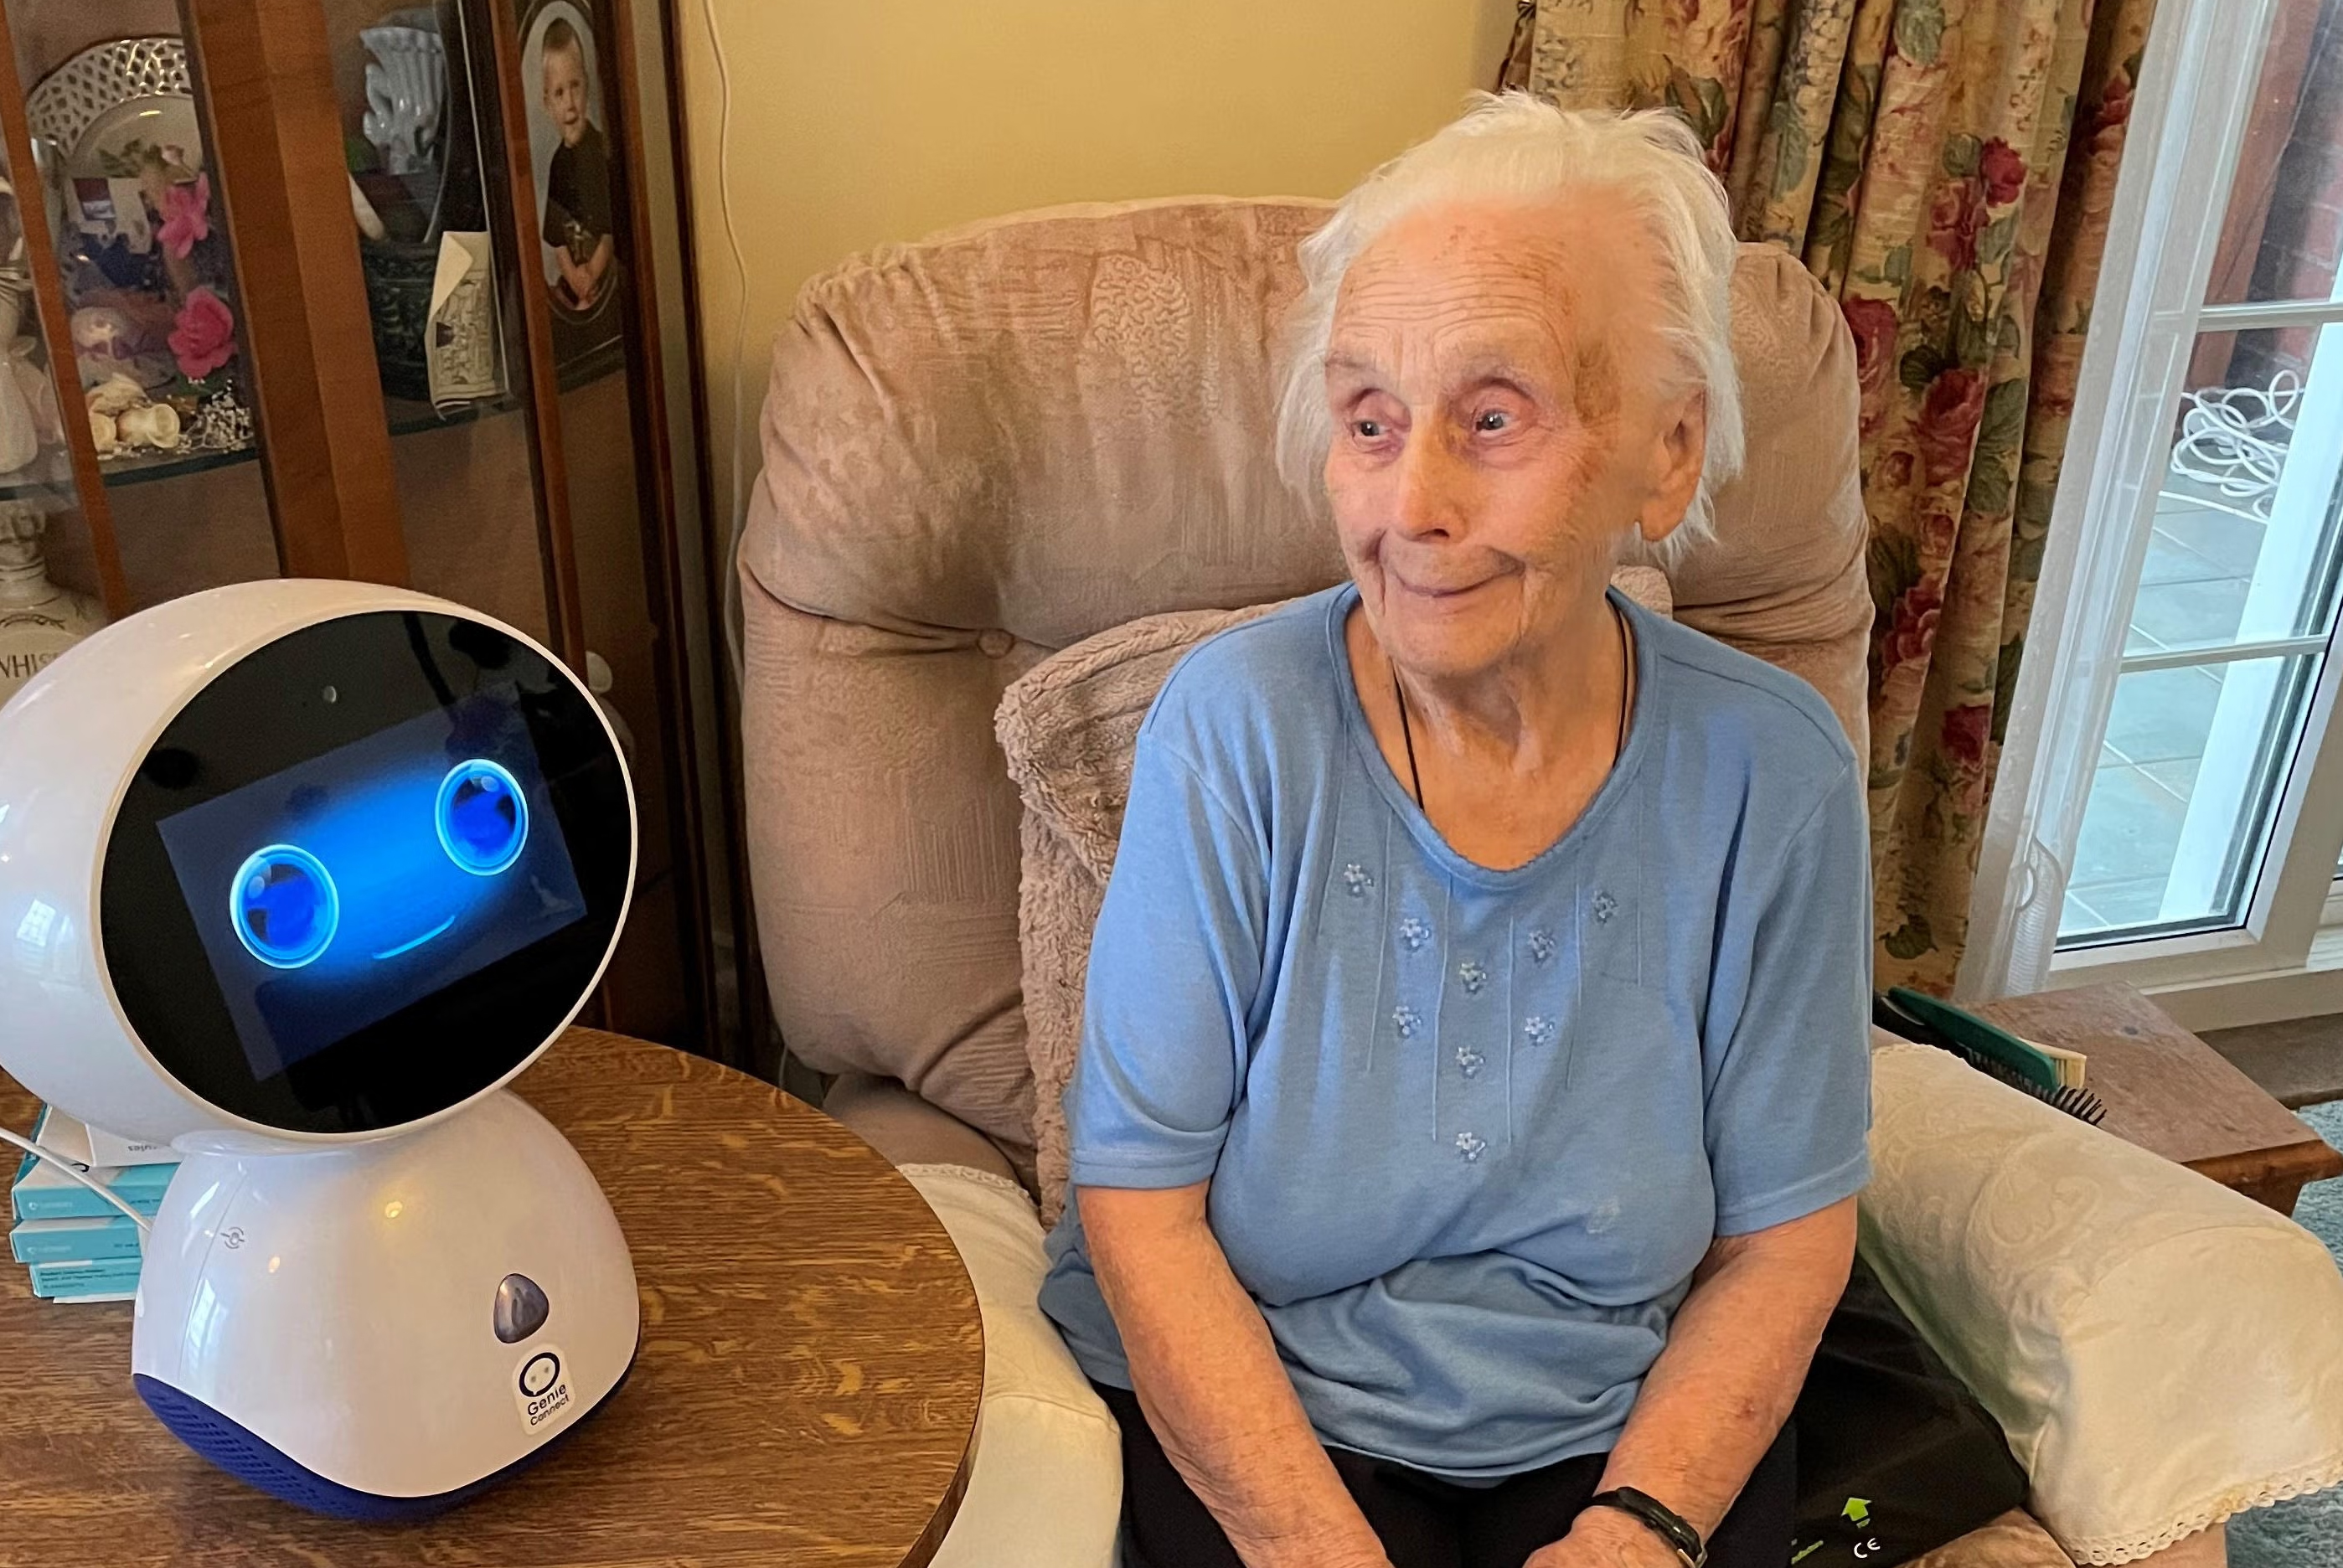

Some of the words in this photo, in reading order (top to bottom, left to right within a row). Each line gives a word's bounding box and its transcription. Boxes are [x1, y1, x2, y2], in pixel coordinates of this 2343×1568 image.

[528, 1384, 566, 1416] Genie
[529, 1394, 570, 1426] Connect
[1854, 1538, 1881, 1558] CE
